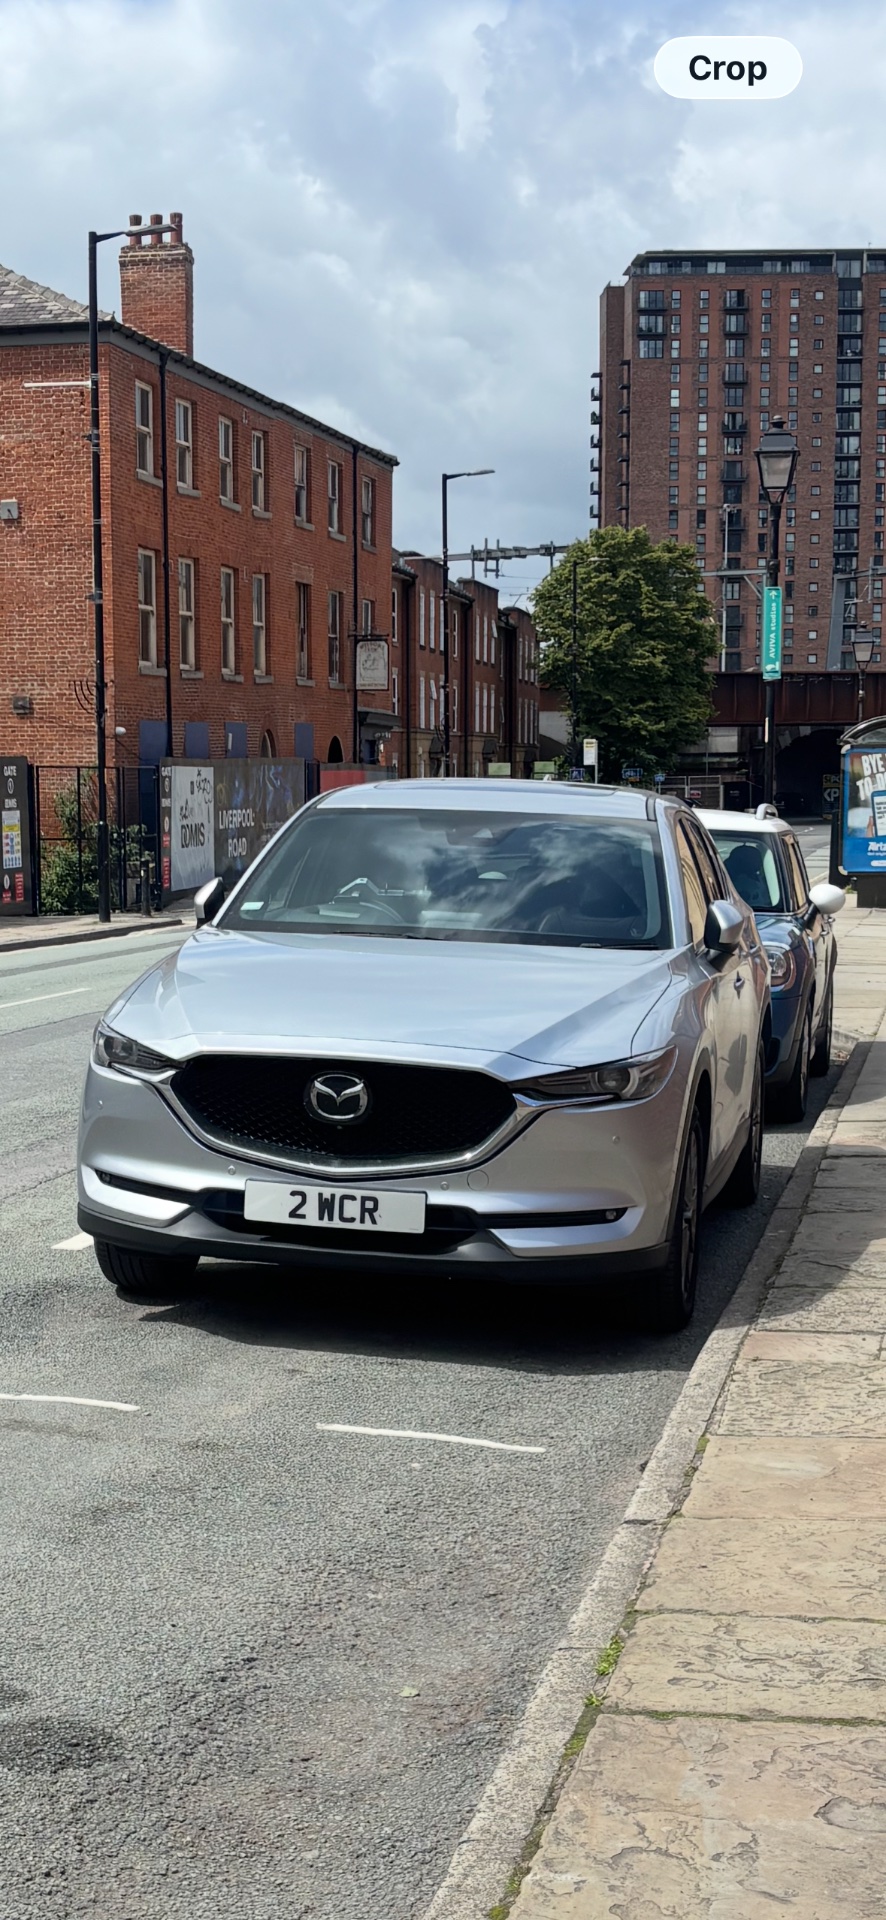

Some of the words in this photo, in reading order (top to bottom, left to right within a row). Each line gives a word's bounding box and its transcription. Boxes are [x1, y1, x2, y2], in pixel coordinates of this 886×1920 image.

[3, 766, 17, 777] GATE
[861, 754, 886, 776] BYE
[219, 808, 255, 830] LIVERPOOL
[181, 822, 206, 849] DOMIS
[228, 837, 247, 858] ROAD
[288, 1190, 307, 1219] 2
[317, 1192, 379, 1225] WCR
